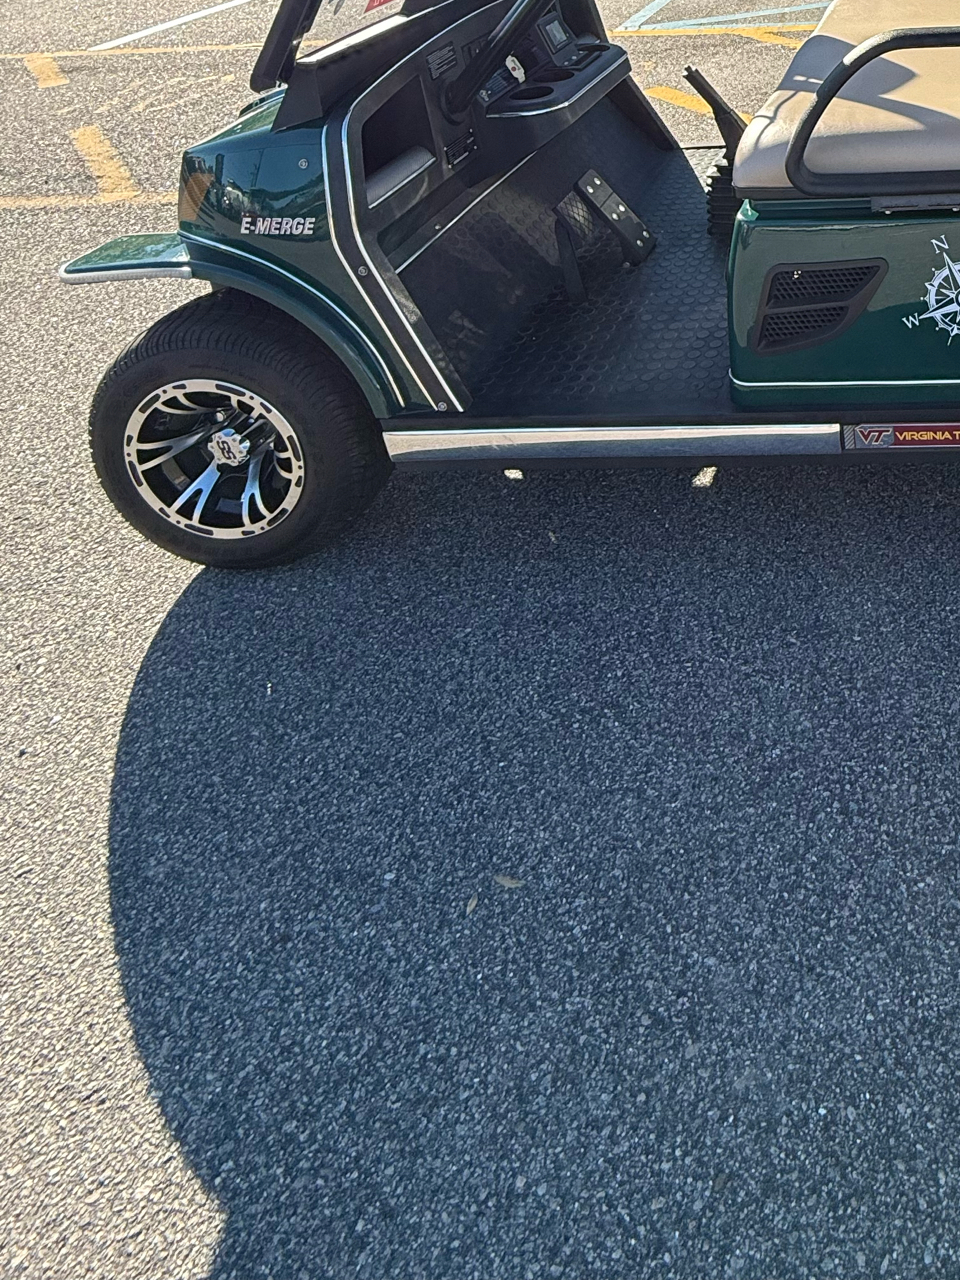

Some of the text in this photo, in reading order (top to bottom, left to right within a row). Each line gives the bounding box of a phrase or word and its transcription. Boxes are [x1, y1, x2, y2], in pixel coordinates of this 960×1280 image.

[240, 217, 316, 235] E-MERGE
[930, 234, 950, 254] N
[902, 312, 920, 329] W
[857, 427, 893, 445] VT
[895, 430, 952, 441] VIRGINIA
